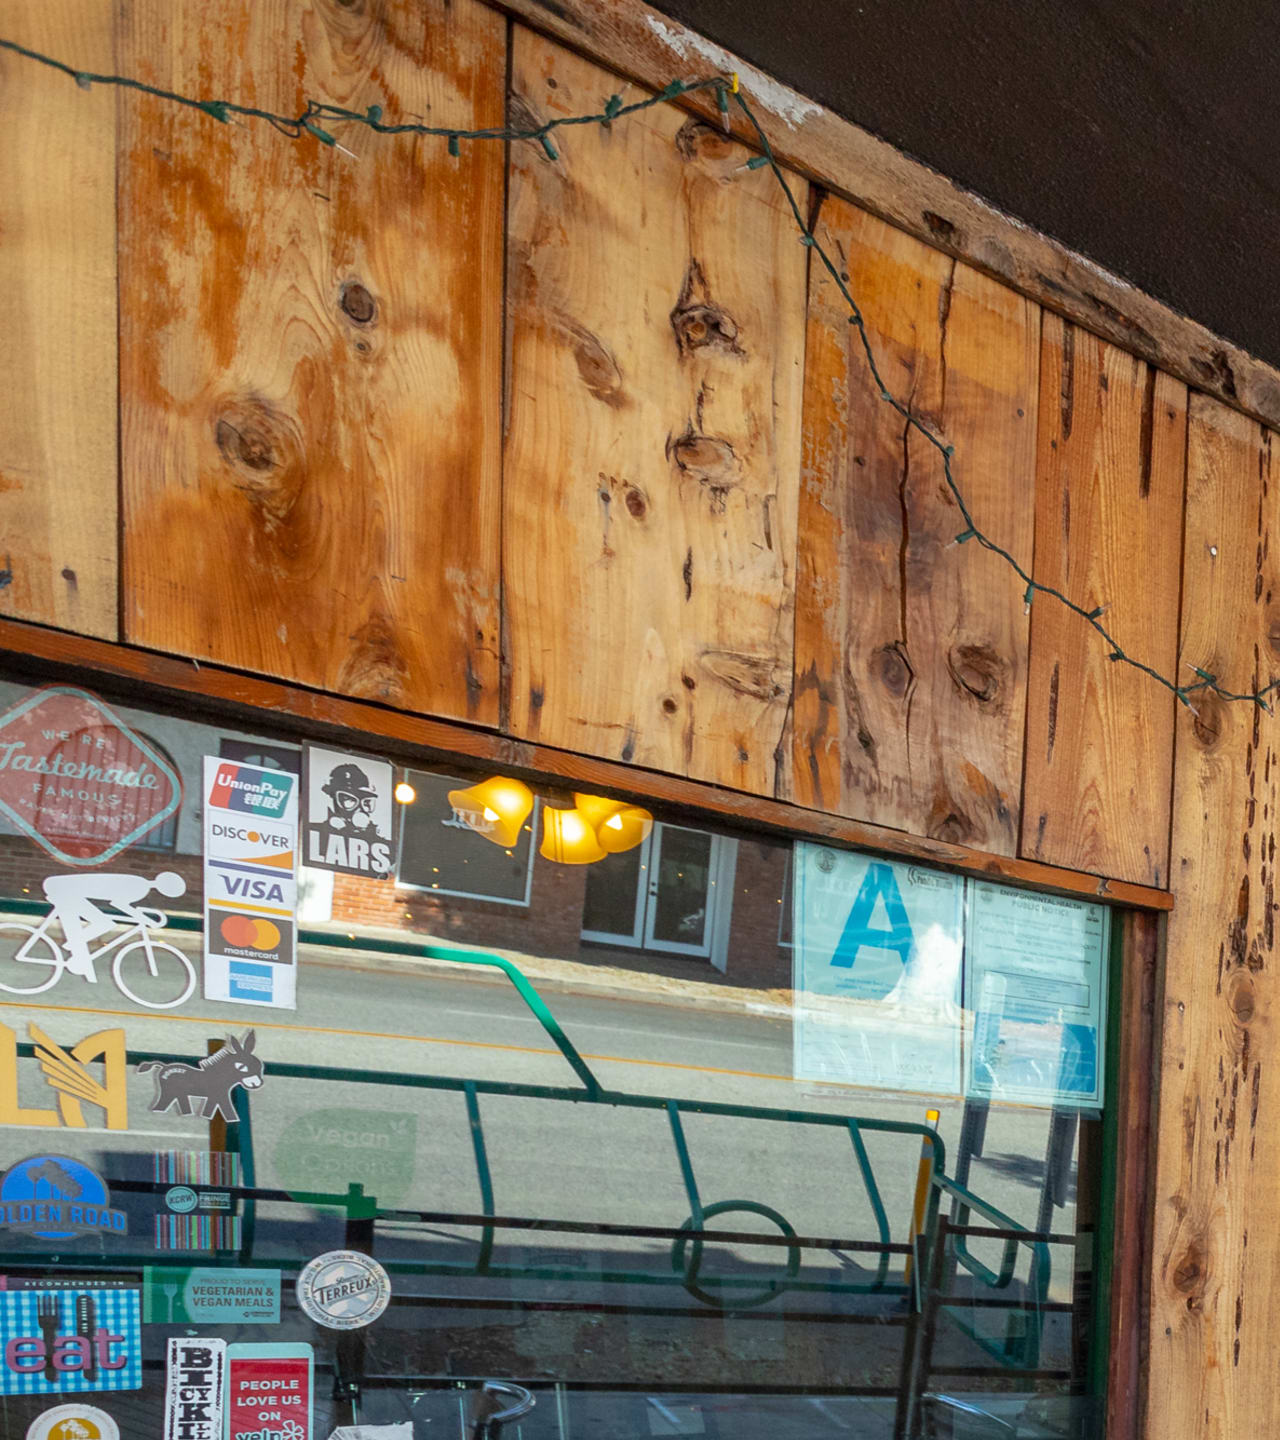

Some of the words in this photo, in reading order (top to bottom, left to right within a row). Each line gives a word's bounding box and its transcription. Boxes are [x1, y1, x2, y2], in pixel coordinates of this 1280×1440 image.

[0, 741, 159, 790] Tastemade
[33, 783, 122, 806] FAMOUS
[218, 773, 287, 802] UnionPay
[212, 824, 289, 848] DISCOVER
[309, 829, 391, 874] LARS
[218, 874, 285, 903] VISA
[830, 862, 918, 977] A
[223, 945, 279, 961] mastercard
[71, 1206, 125, 1231] ROAD
[192, 1286, 262, 1296] VEGETARIAN
[265, 1286, 274, 1297] &
[192, 1298, 231, 1307] VEGAN
[235, 1298, 273, 1307] MEALS
[5, 1328, 127, 1373] eat
[240, 1380, 299, 1391] PEOPLE
[237, 1396, 278, 1407] LOVE
[281, 1395, 302, 1405] US
[258, 1411, 281, 1422] ON
